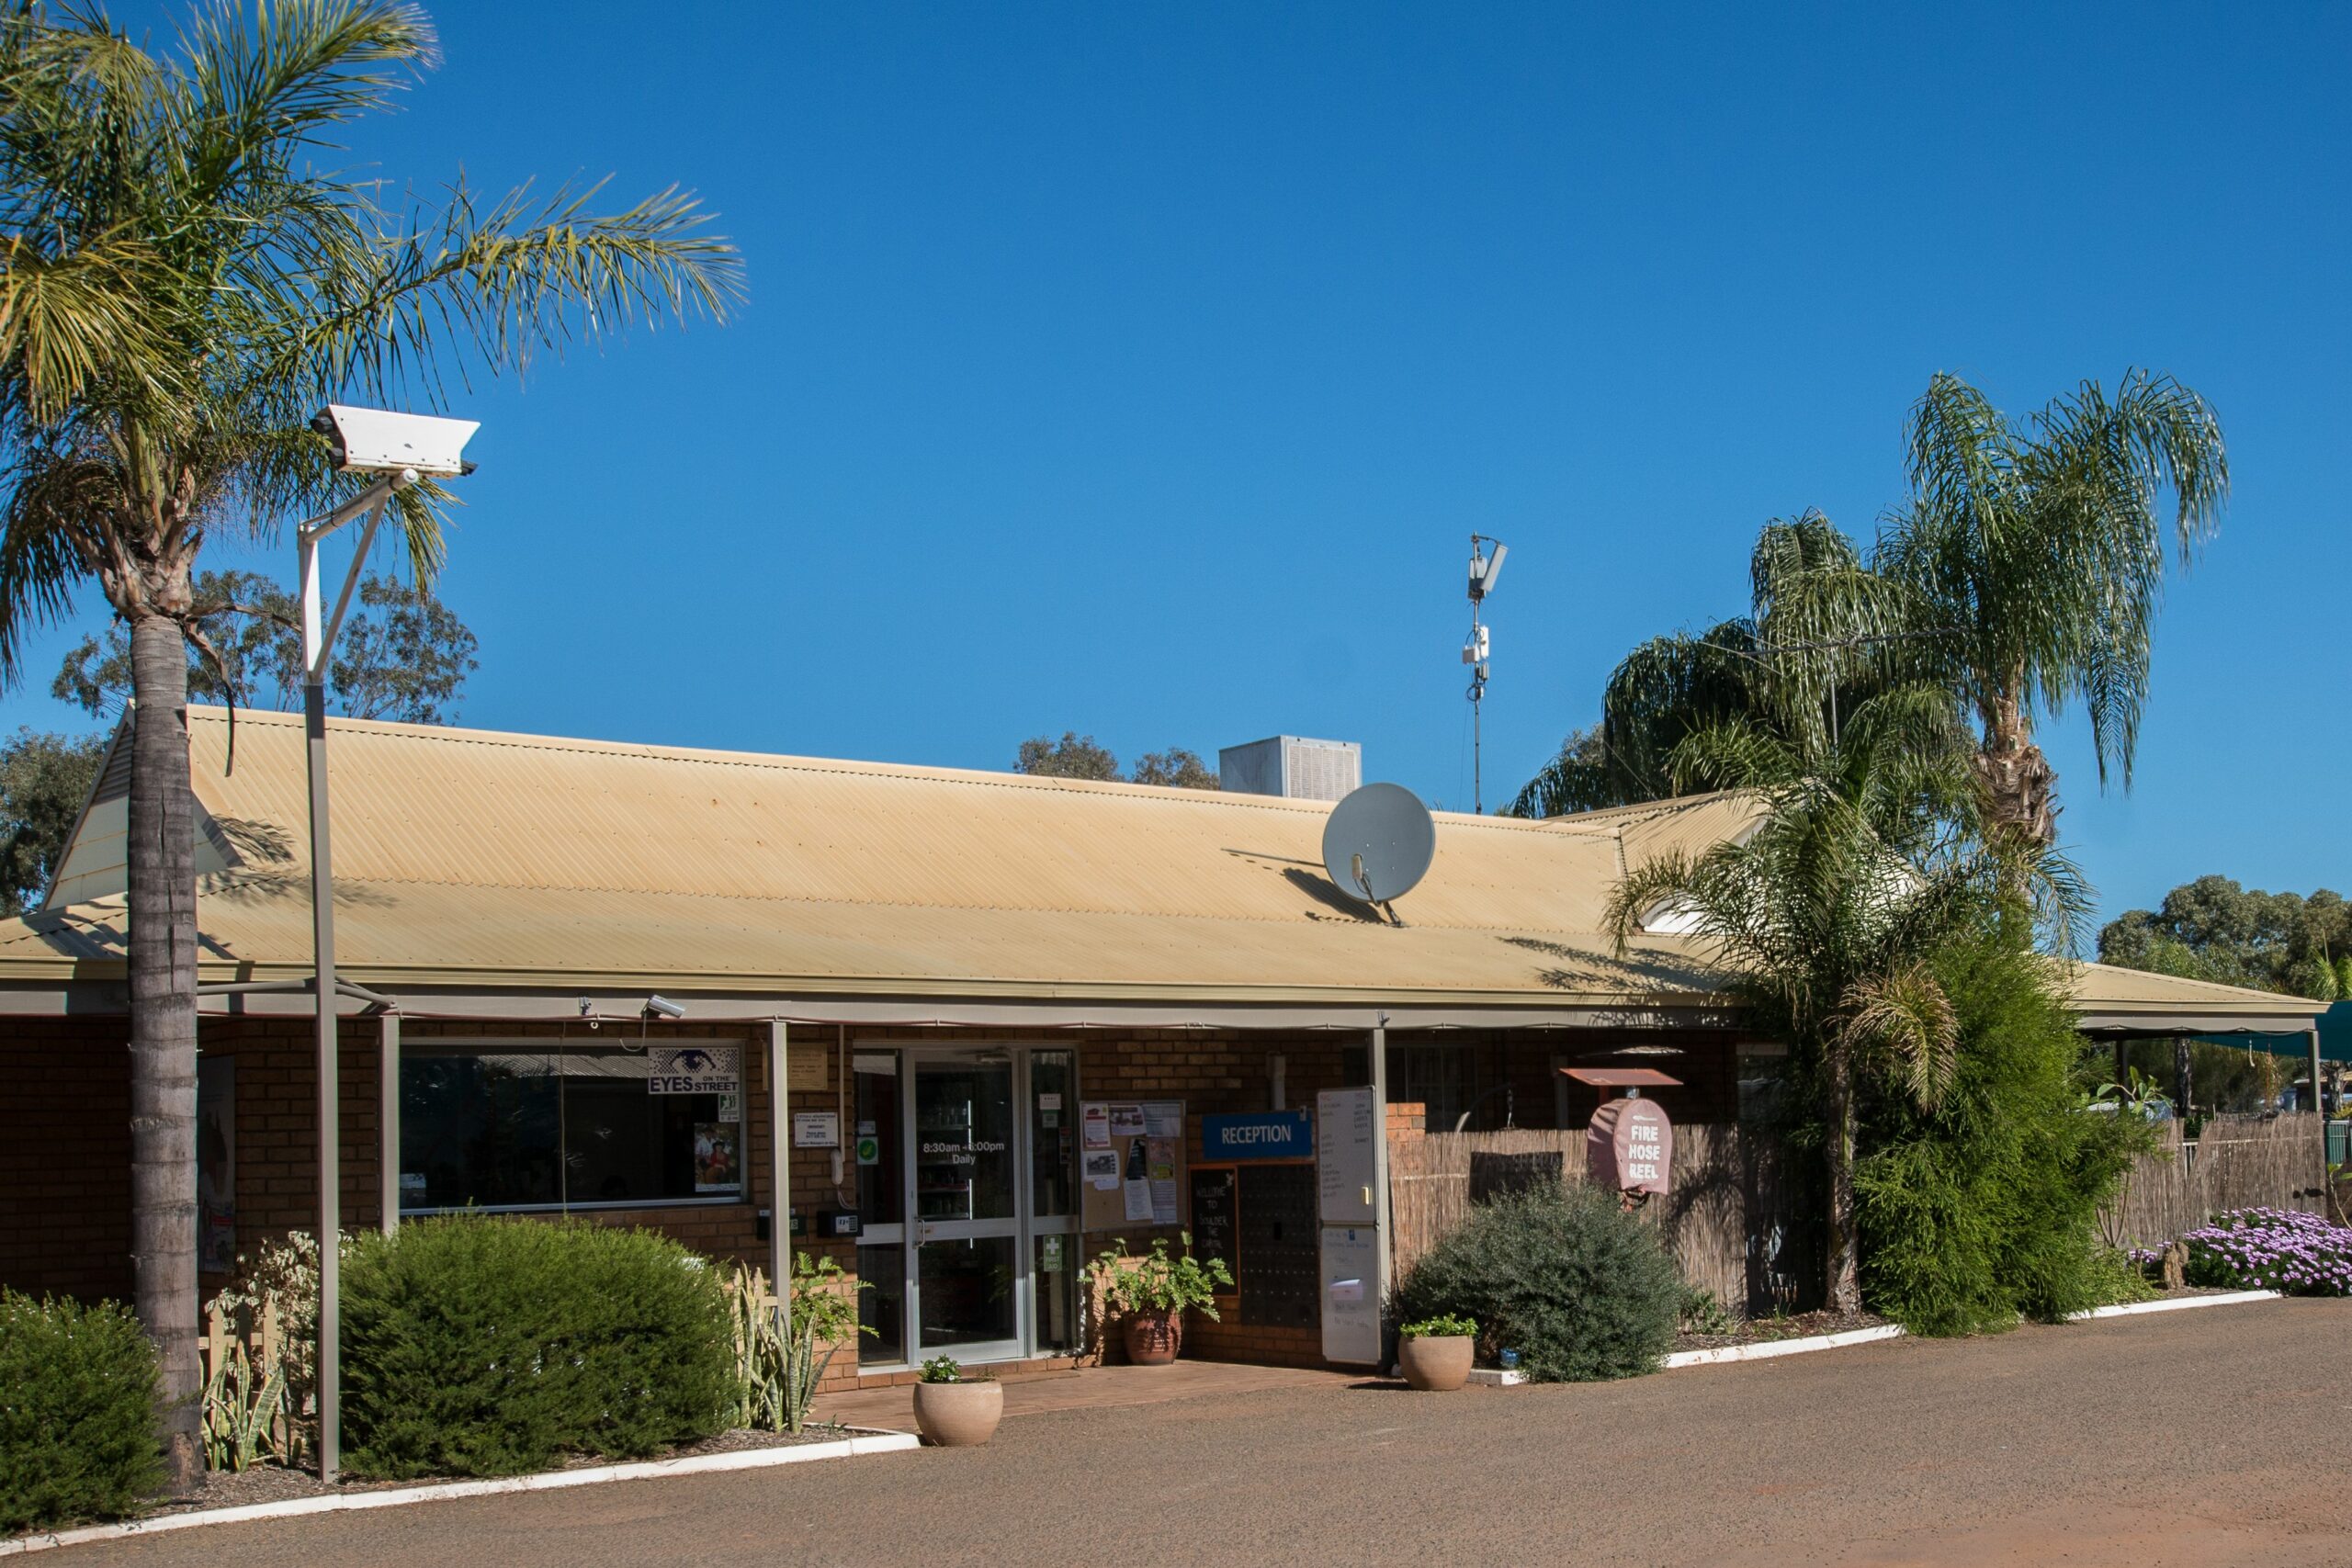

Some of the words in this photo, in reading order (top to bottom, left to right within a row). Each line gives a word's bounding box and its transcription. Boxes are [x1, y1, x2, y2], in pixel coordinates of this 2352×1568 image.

[650, 1076, 693, 1092] EYES
[695, 1082, 738, 1091] STREET
[1222, 1124, 1292, 1145] RECEPTION
[1631, 1124, 1658, 1142] FIRE
[922, 1143, 960, 1153] 8:30am
[1629, 1144, 1660, 1160] HOSE
[952, 1154, 976, 1166] Daily
[1629, 1163, 1659, 1179] REEL
[1206, 1200, 1218, 1209] TO
